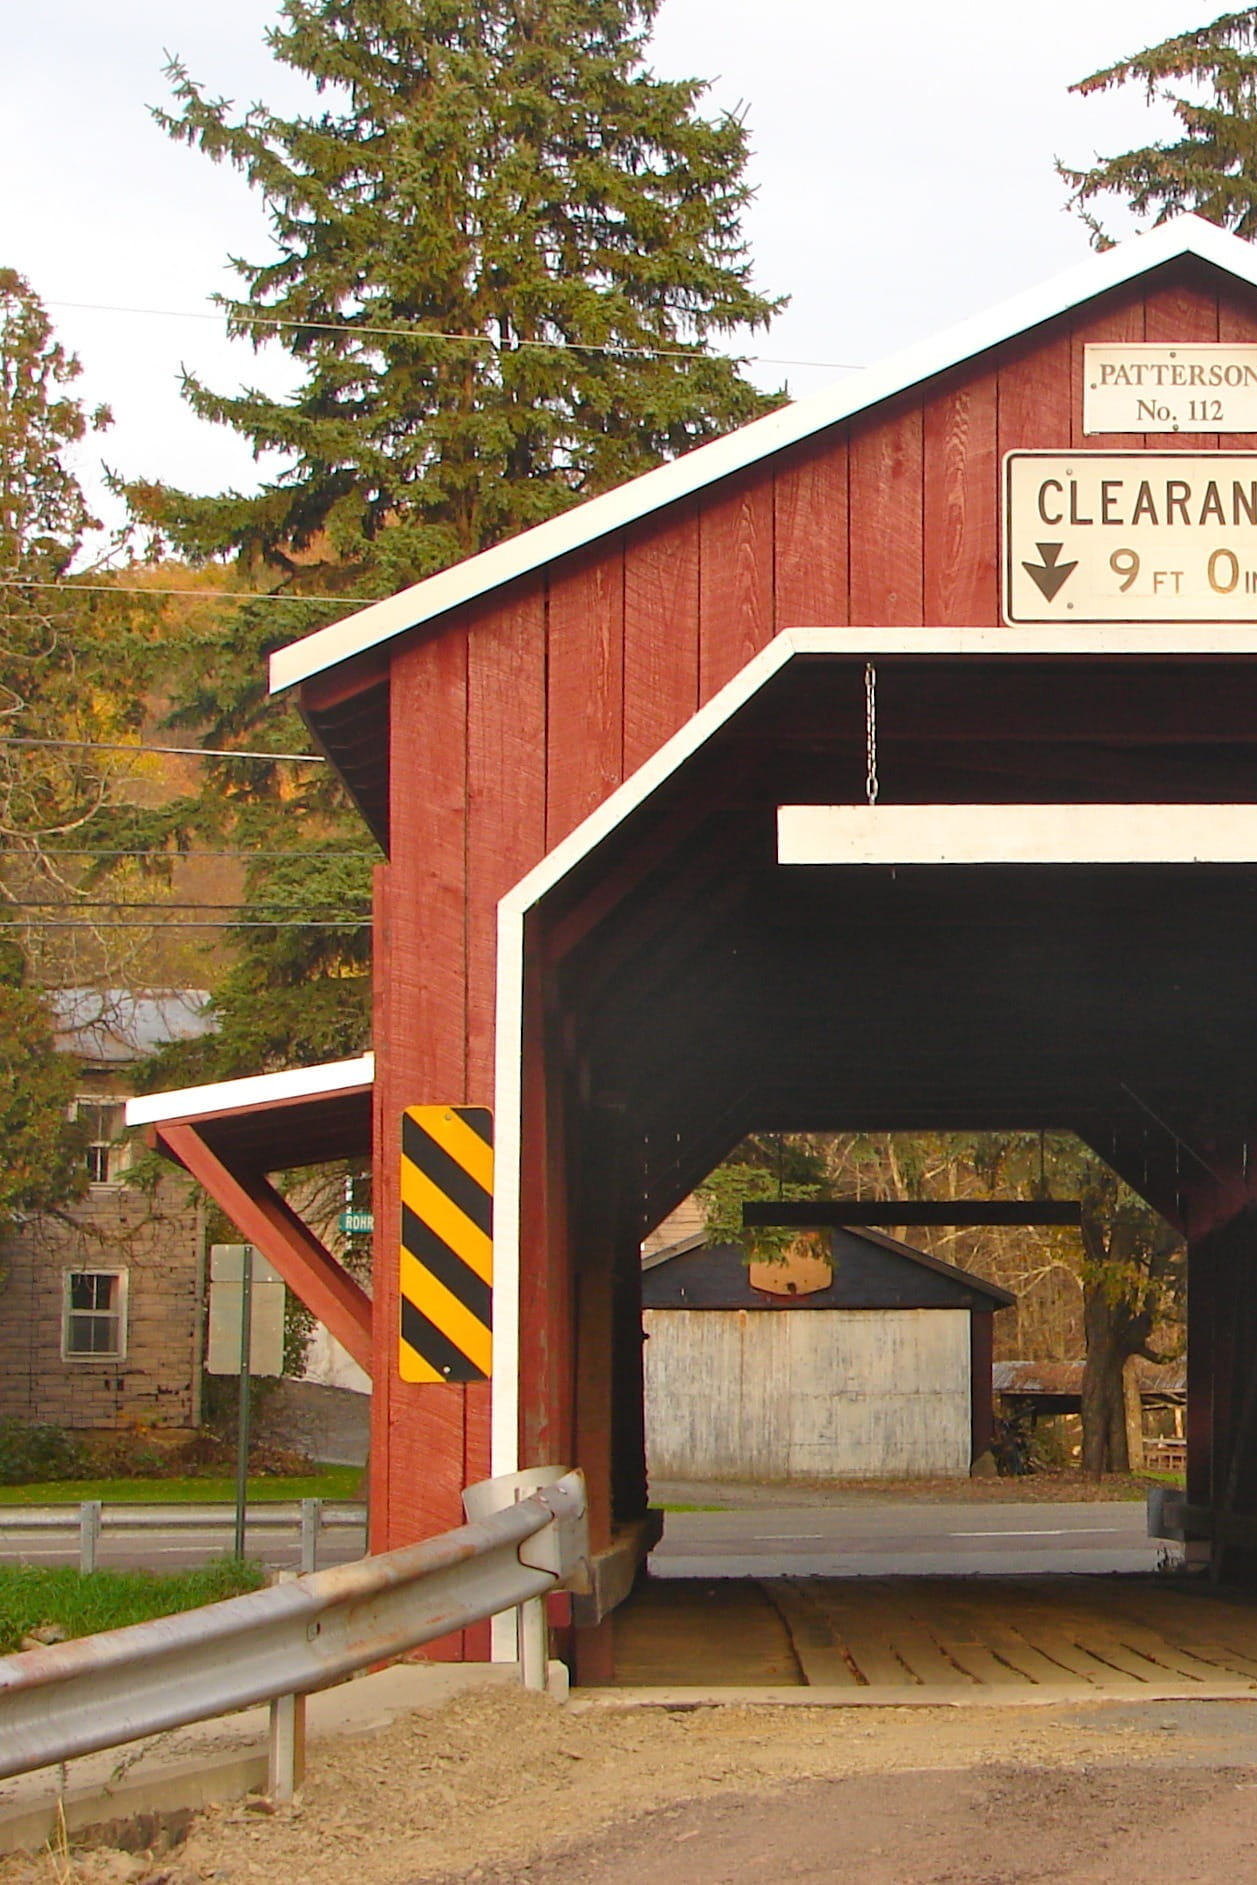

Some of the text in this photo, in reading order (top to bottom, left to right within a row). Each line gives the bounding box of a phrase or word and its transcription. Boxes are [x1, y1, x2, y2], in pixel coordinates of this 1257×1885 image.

[1136, 399, 1224, 421] No. 112
[1109, 548, 1141, 593] 9
[1153, 571, 1184, 593] FT
[345, 1215, 374, 1231] ROHR
